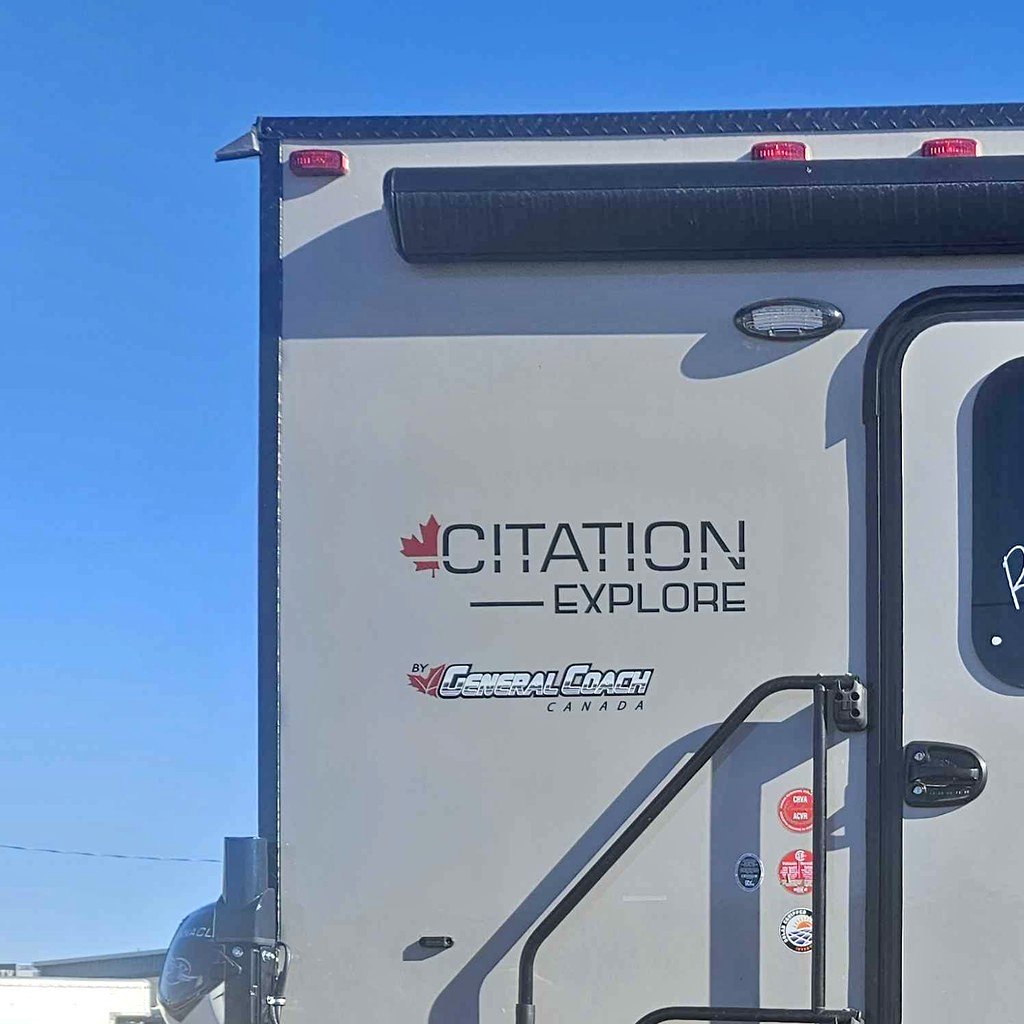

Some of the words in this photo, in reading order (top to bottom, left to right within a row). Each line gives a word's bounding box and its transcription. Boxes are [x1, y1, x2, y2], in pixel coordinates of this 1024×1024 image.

[442, 519, 746, 575] CITATION
[553, 581, 746, 614] EXPLORE
[411, 663, 430, 673] BY
[438, 663, 560, 699] GENERAL
[560, 662, 654, 697] COACH
[546, 700, 645, 713] CANADA
